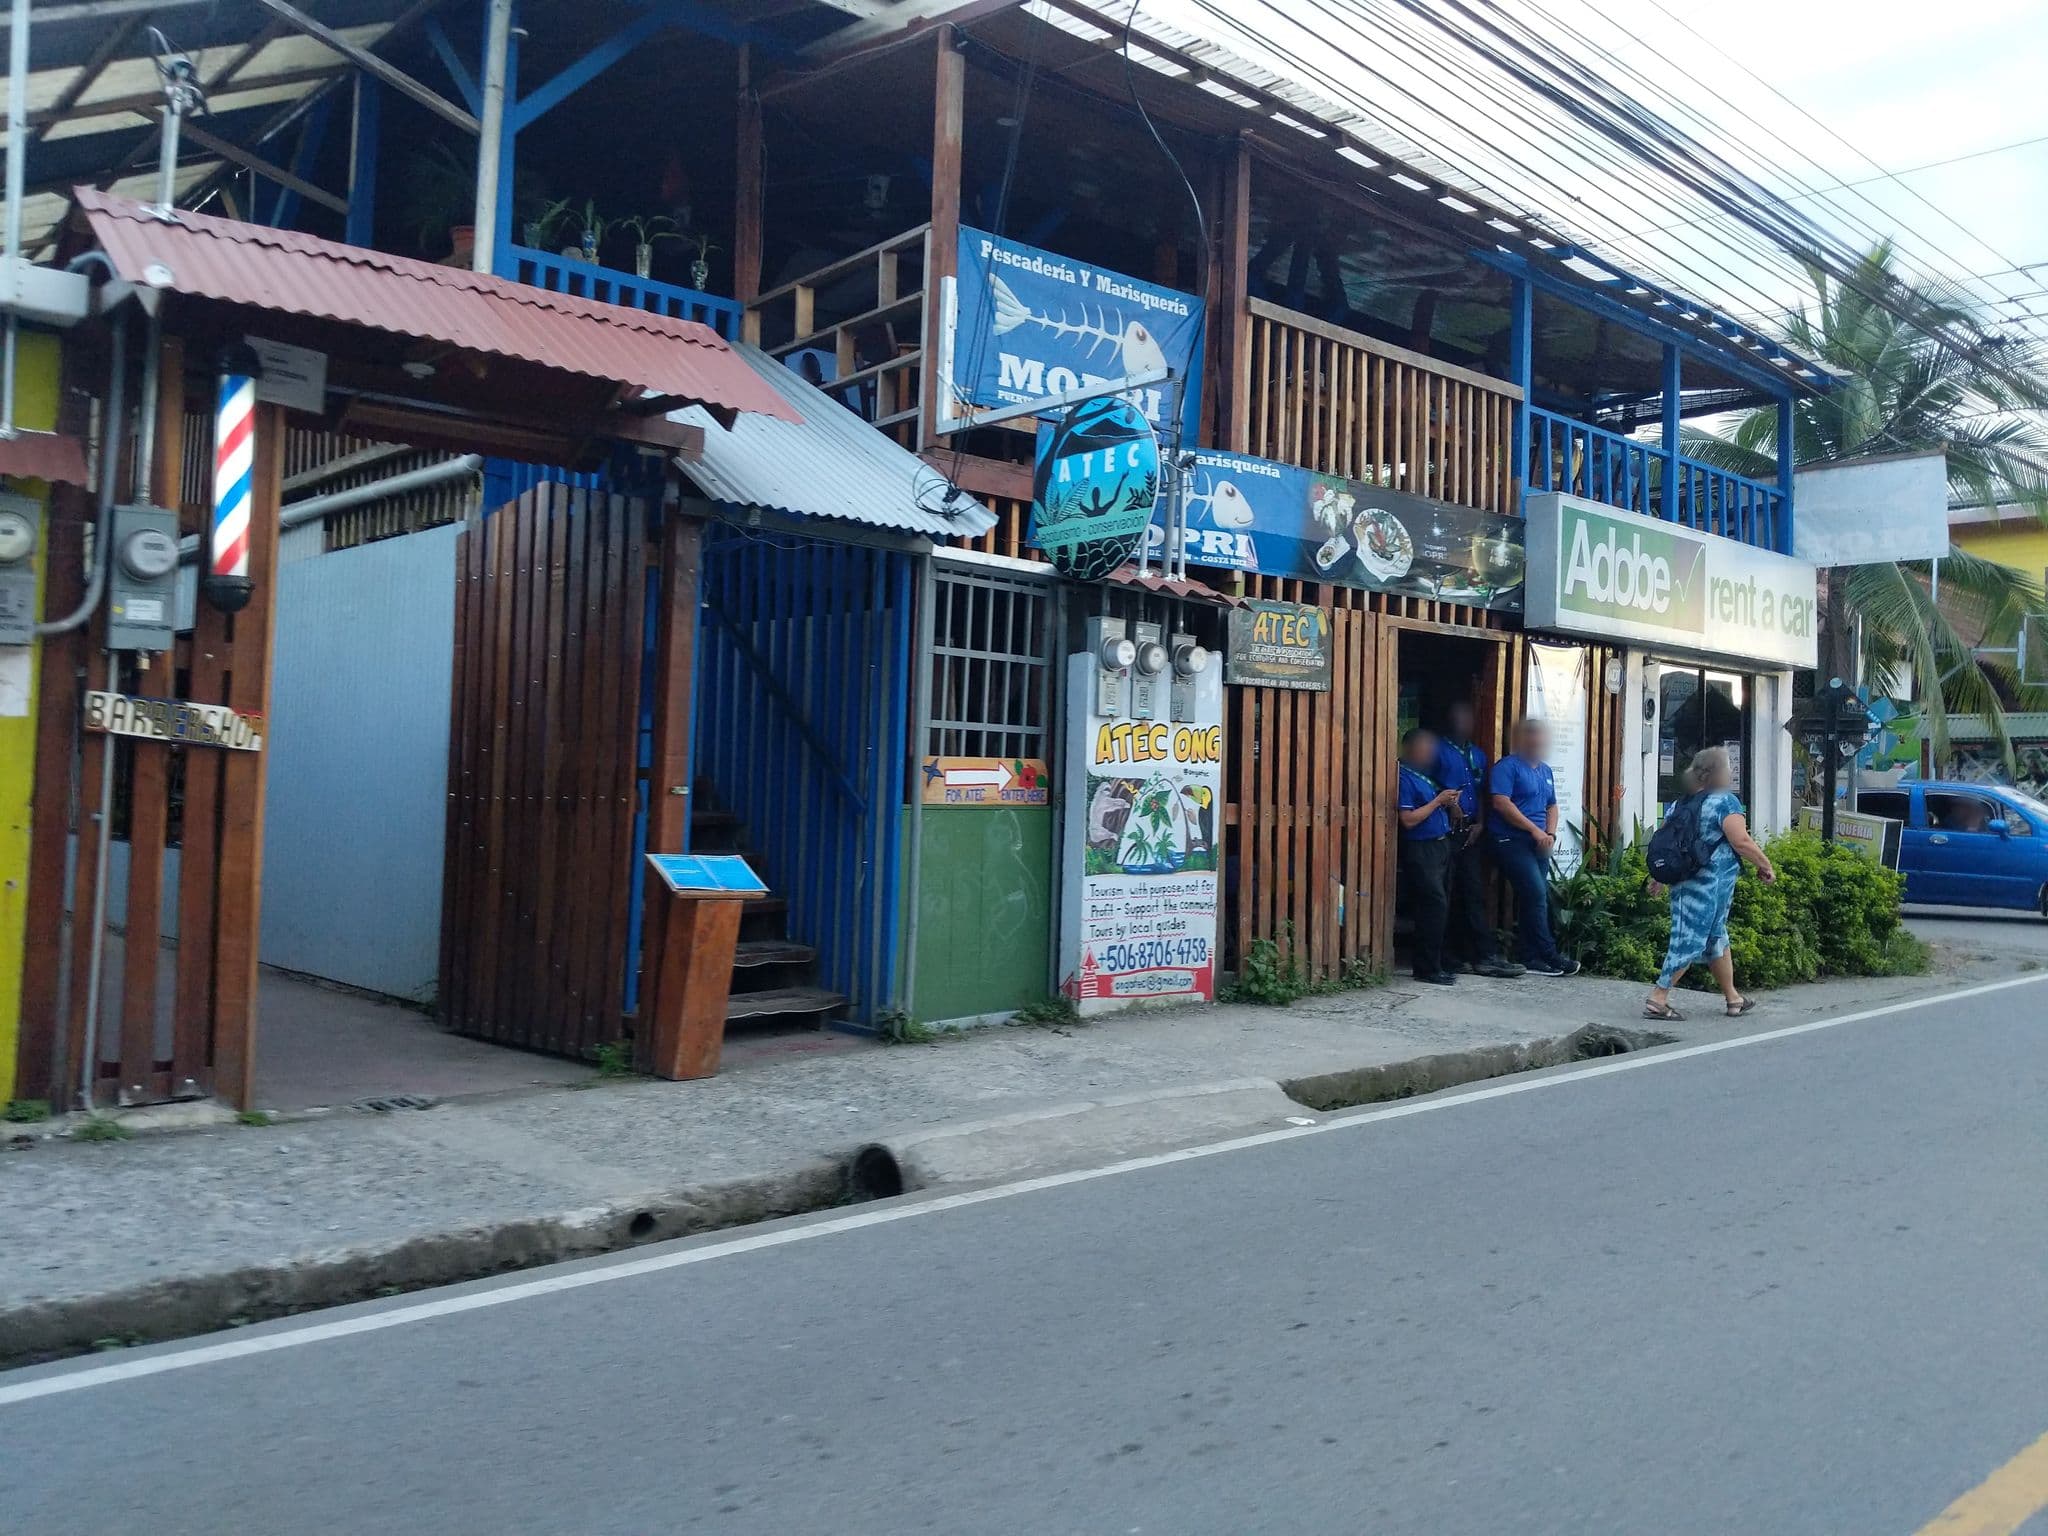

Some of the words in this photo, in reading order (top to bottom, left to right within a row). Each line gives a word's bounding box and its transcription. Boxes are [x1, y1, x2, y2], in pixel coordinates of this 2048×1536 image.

[980, 239, 1076, 284] Pescadería
[1080, 269, 1092, 287] Y
[1096, 273, 1189, 316] Marisquería
[1058, 443, 1140, 483] ATEC
[1564, 518, 1671, 614] Adobe
[1710, 574, 1757, 627] rent
[1762, 586, 1776, 631] a
[1780, 592, 1815, 638] car
[1253, 611, 1311, 648] ATEC
[1095, 722, 1169, 765] ATEC
[1173, 725, 1221, 764] ONG
[945, 789, 962, 802] FOR
[964, 788, 985, 801] ATEC
[1001, 789, 1025, 802] ENTER
[1089, 883, 1124, 897] Tourism
[1129, 881, 1147, 895] with
[1150, 884, 1184, 899] purpose,
[1185, 880, 1199, 892] not
[1201, 880, 1214, 891] for
[1089, 924, 1113, 938] Tours
[1116, 922, 1127, 939] by
[1129, 919, 1153, 934] local
[1156, 917, 1186, 938] guides
[1091, 903, 1114, 918] Profit
[1124, 899, 1159, 919] Support
[1163, 899, 1178, 911] the
